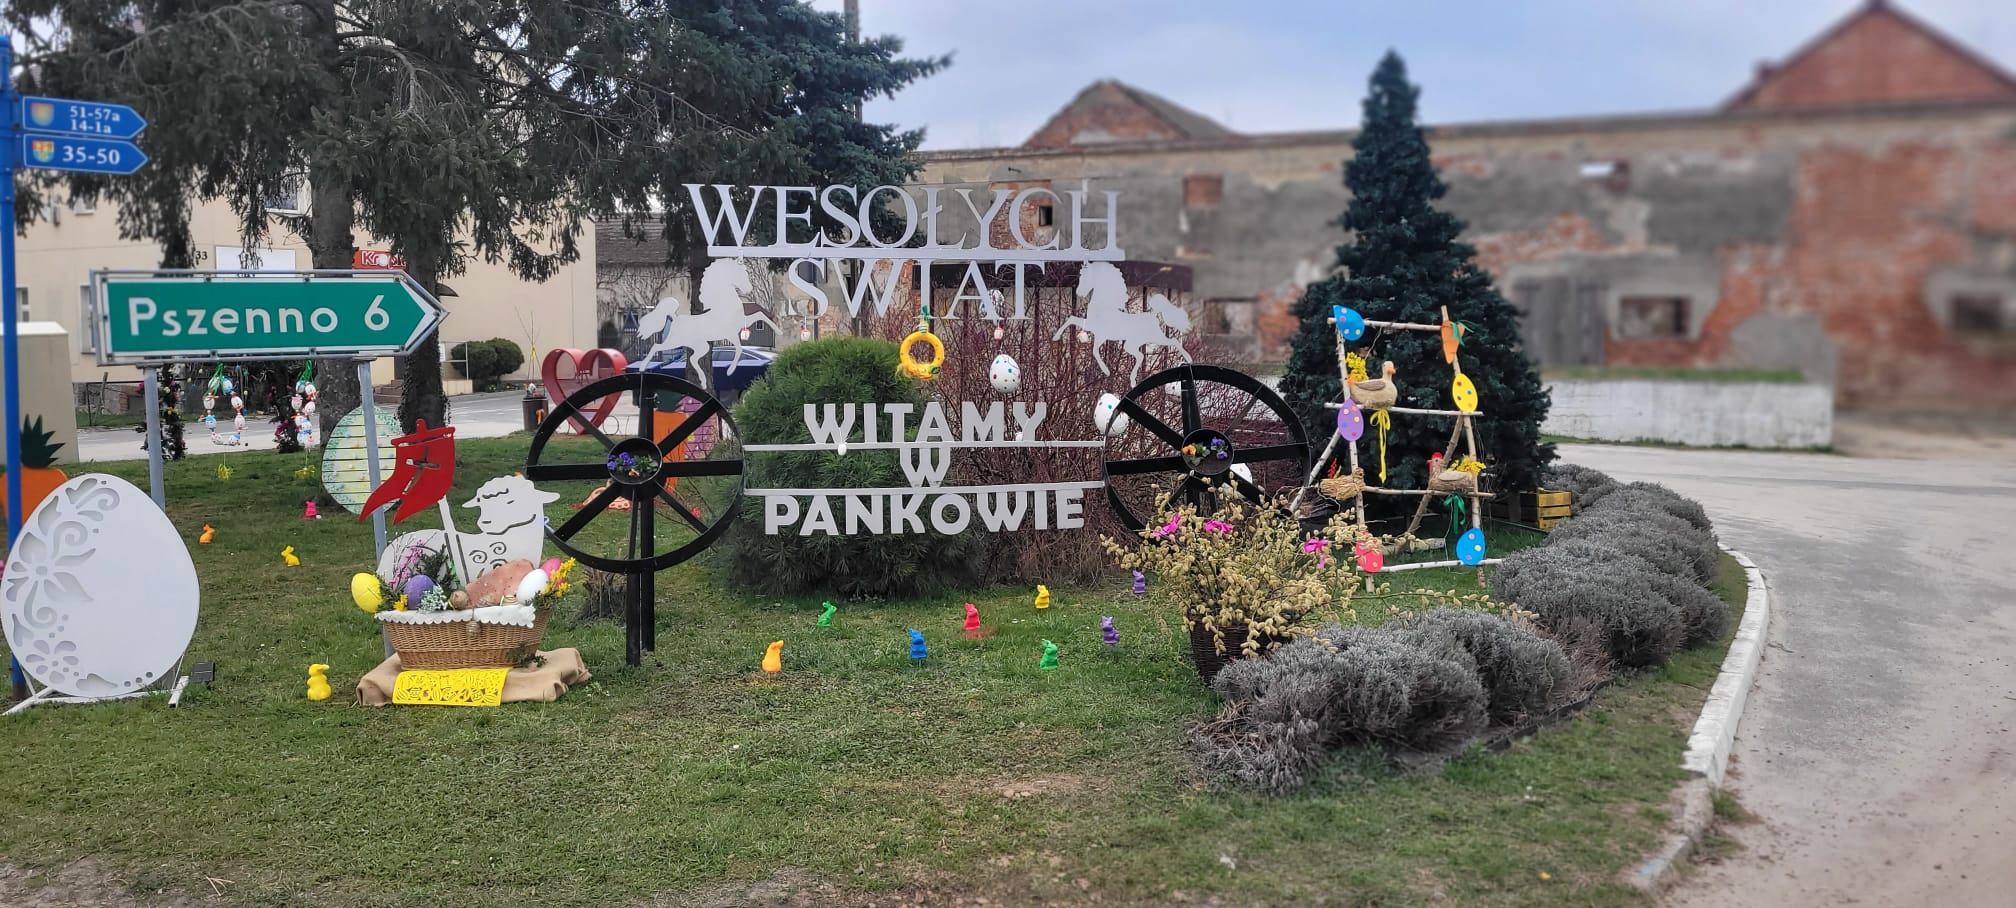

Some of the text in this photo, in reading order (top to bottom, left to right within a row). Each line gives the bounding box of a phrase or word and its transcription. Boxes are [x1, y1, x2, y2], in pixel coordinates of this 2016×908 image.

[69, 105, 120, 122] 51-57a
[71, 118, 112, 134] 14-1a
[62, 145, 120, 165] 35-50
[682, 184, 1125, 251] WESOŁYCH
[128, 294, 390, 337] Pszenno 6
[803, 401, 1047, 444] WITAMY
[900, 446, 951, 488] W
[764, 488, 1085, 536] PANKOWIE
